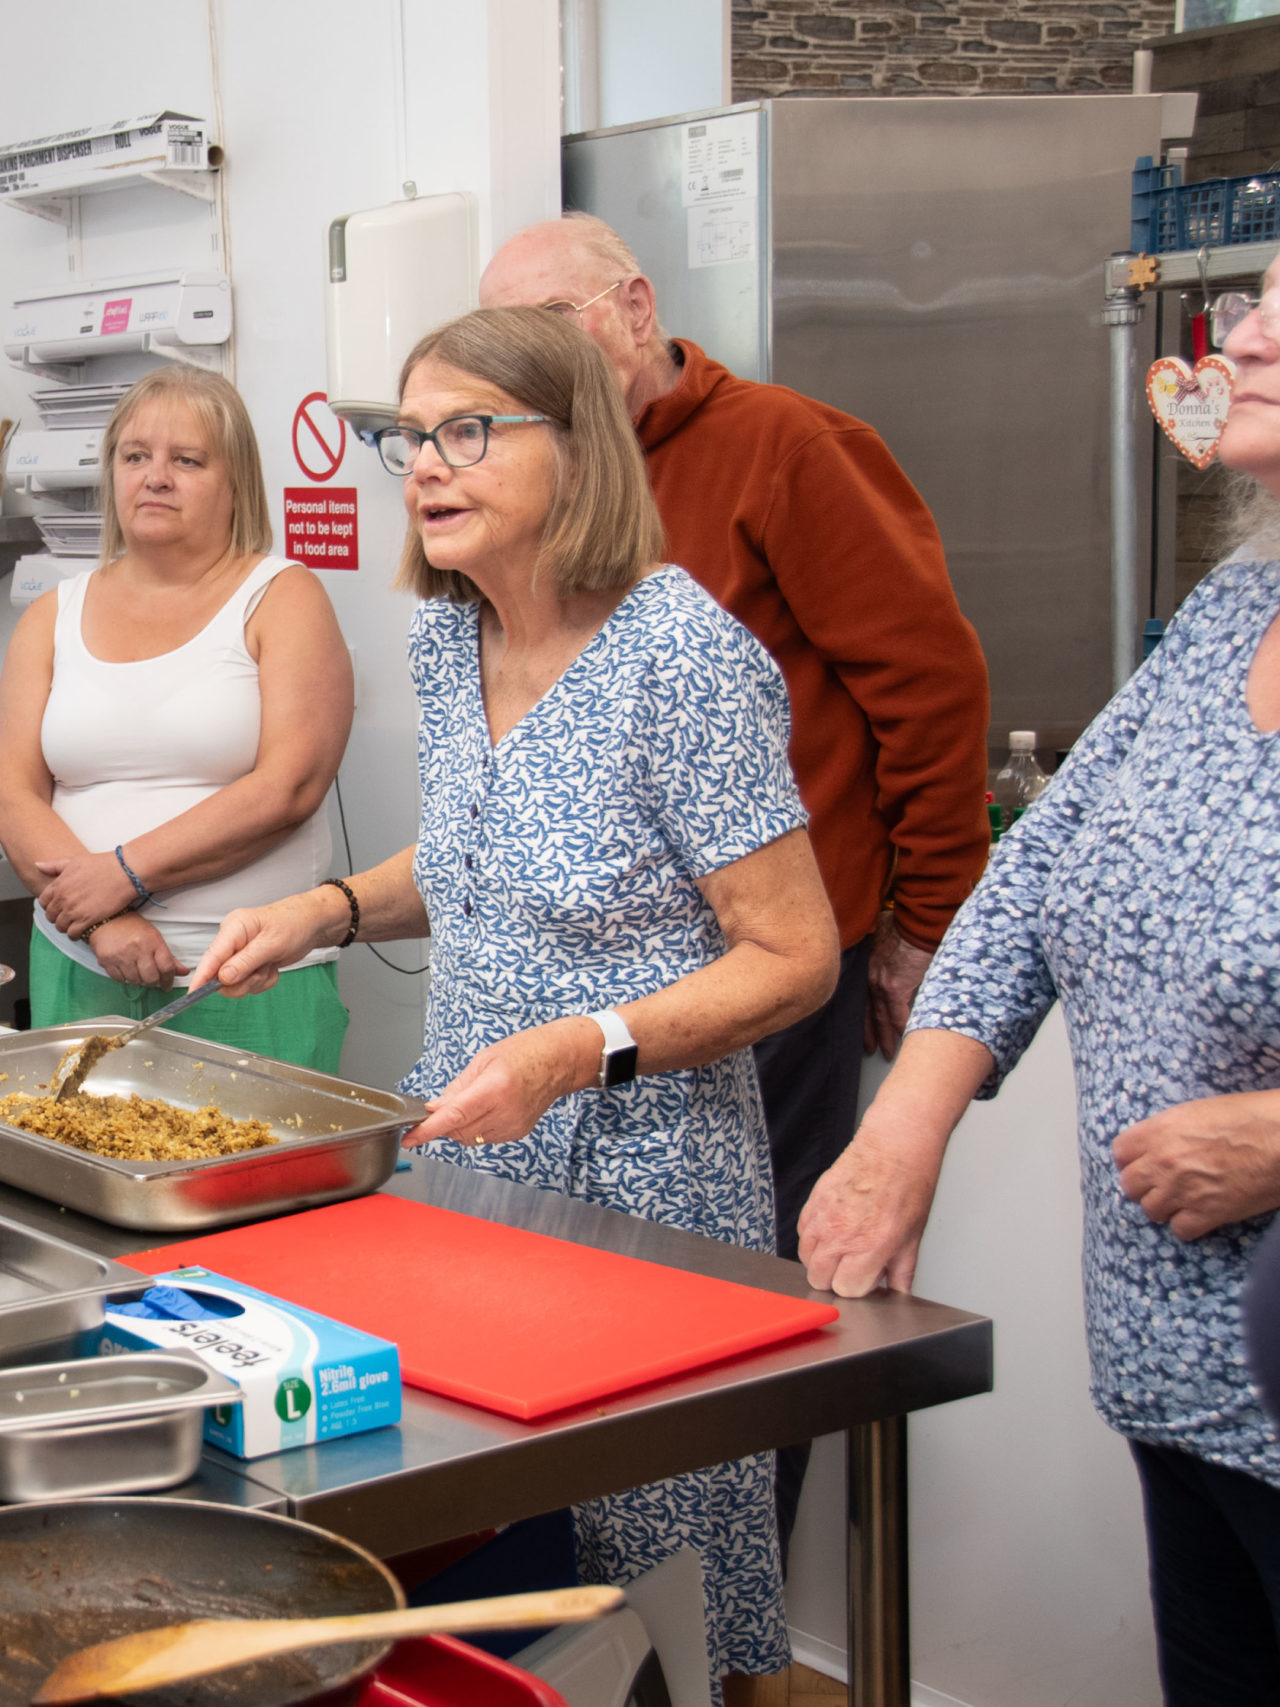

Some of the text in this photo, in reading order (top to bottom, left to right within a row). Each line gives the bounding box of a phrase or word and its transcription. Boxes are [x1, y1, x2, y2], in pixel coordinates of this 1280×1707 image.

[1167, 400, 1220, 416] Donna's
[1180, 419, 1211, 428] Kitchen
[286, 500, 355, 515] Personal items
[289, 521, 353, 538] not to be kept
[293, 542, 349, 556] in food area
[169, 1323, 271, 1368] feelers
[319, 1365, 355, 1383] Nitrile
[283, 1380, 300, 1390] SIZE
[321, 1371, 389, 1397] 2.6mil glove
[286, 1390, 302, 1420] L
[350, 1396, 365, 1404] Free
[330, 1409, 355, 1419] Powder
[358, 1404, 373, 1414] Free
